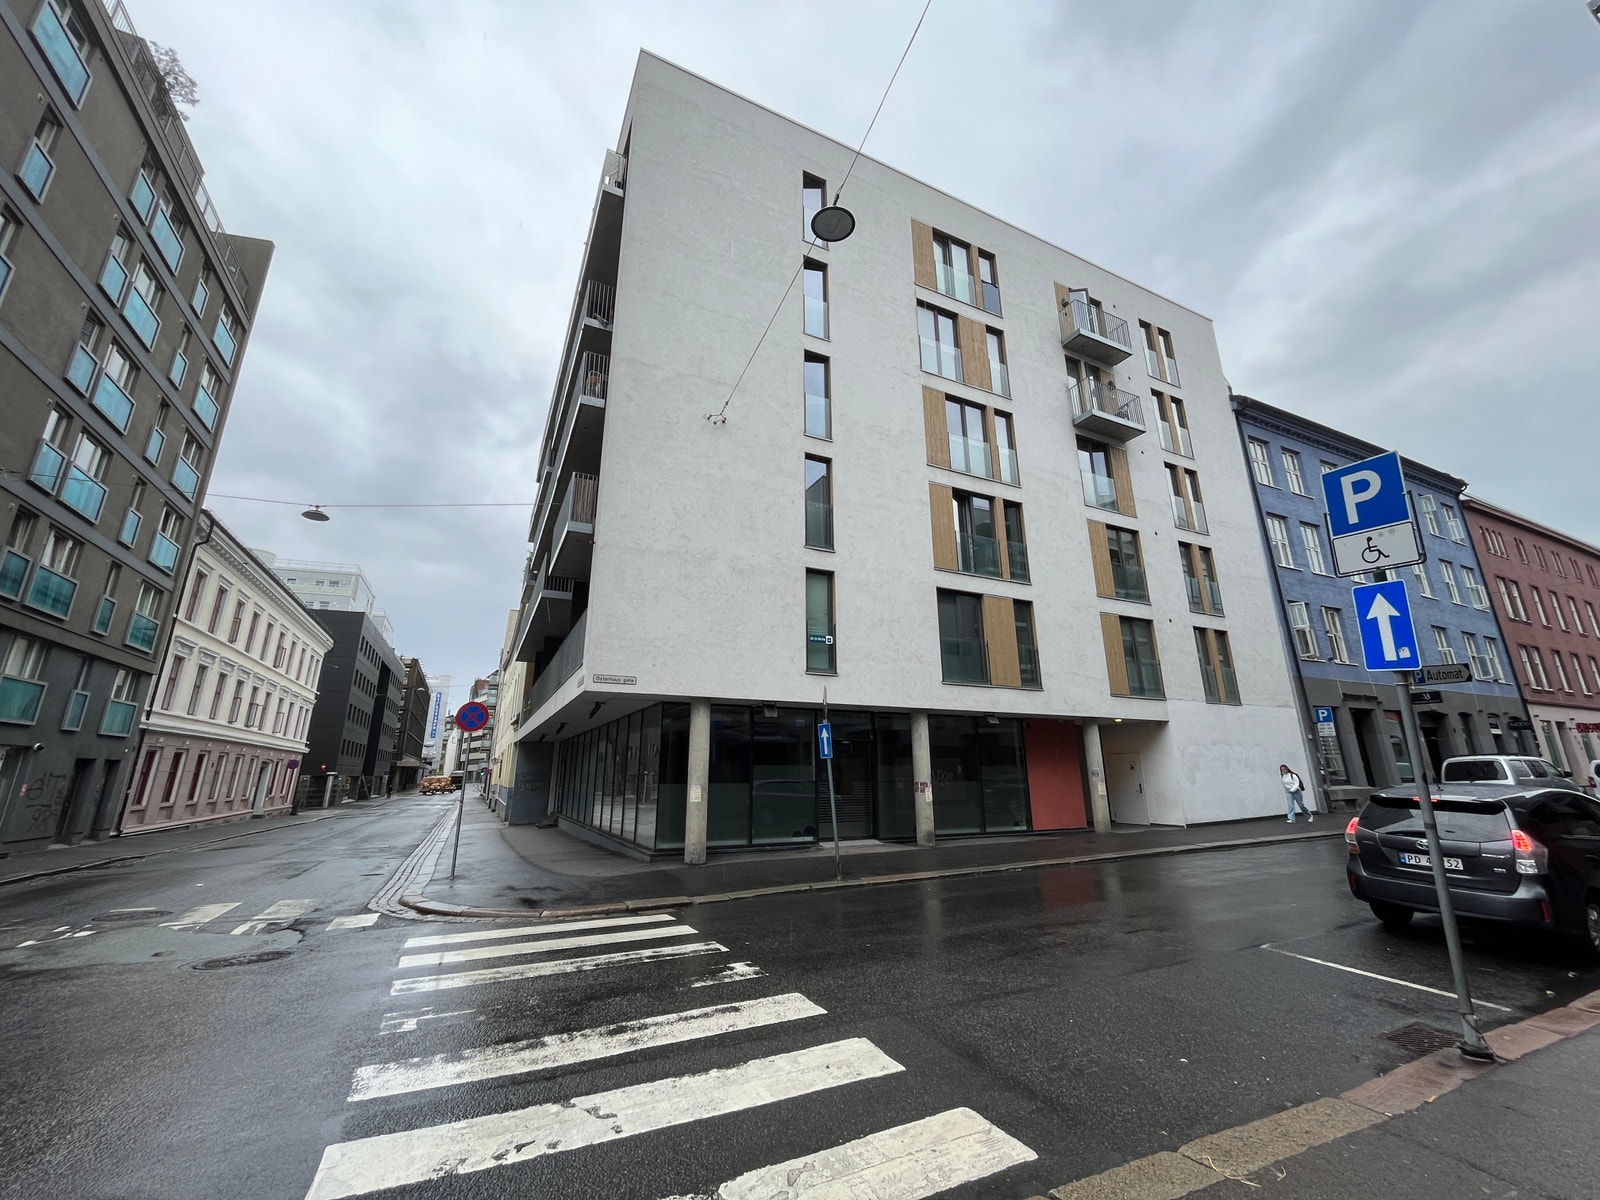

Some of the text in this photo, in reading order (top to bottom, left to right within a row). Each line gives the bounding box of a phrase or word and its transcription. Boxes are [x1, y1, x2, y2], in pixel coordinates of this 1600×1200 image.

[1340, 469, 1382, 525] P
[1414, 668, 1464, 683] P Automat
[1318, 709, 1328, 722] P
[1407, 854, 1461, 869] PD 452
